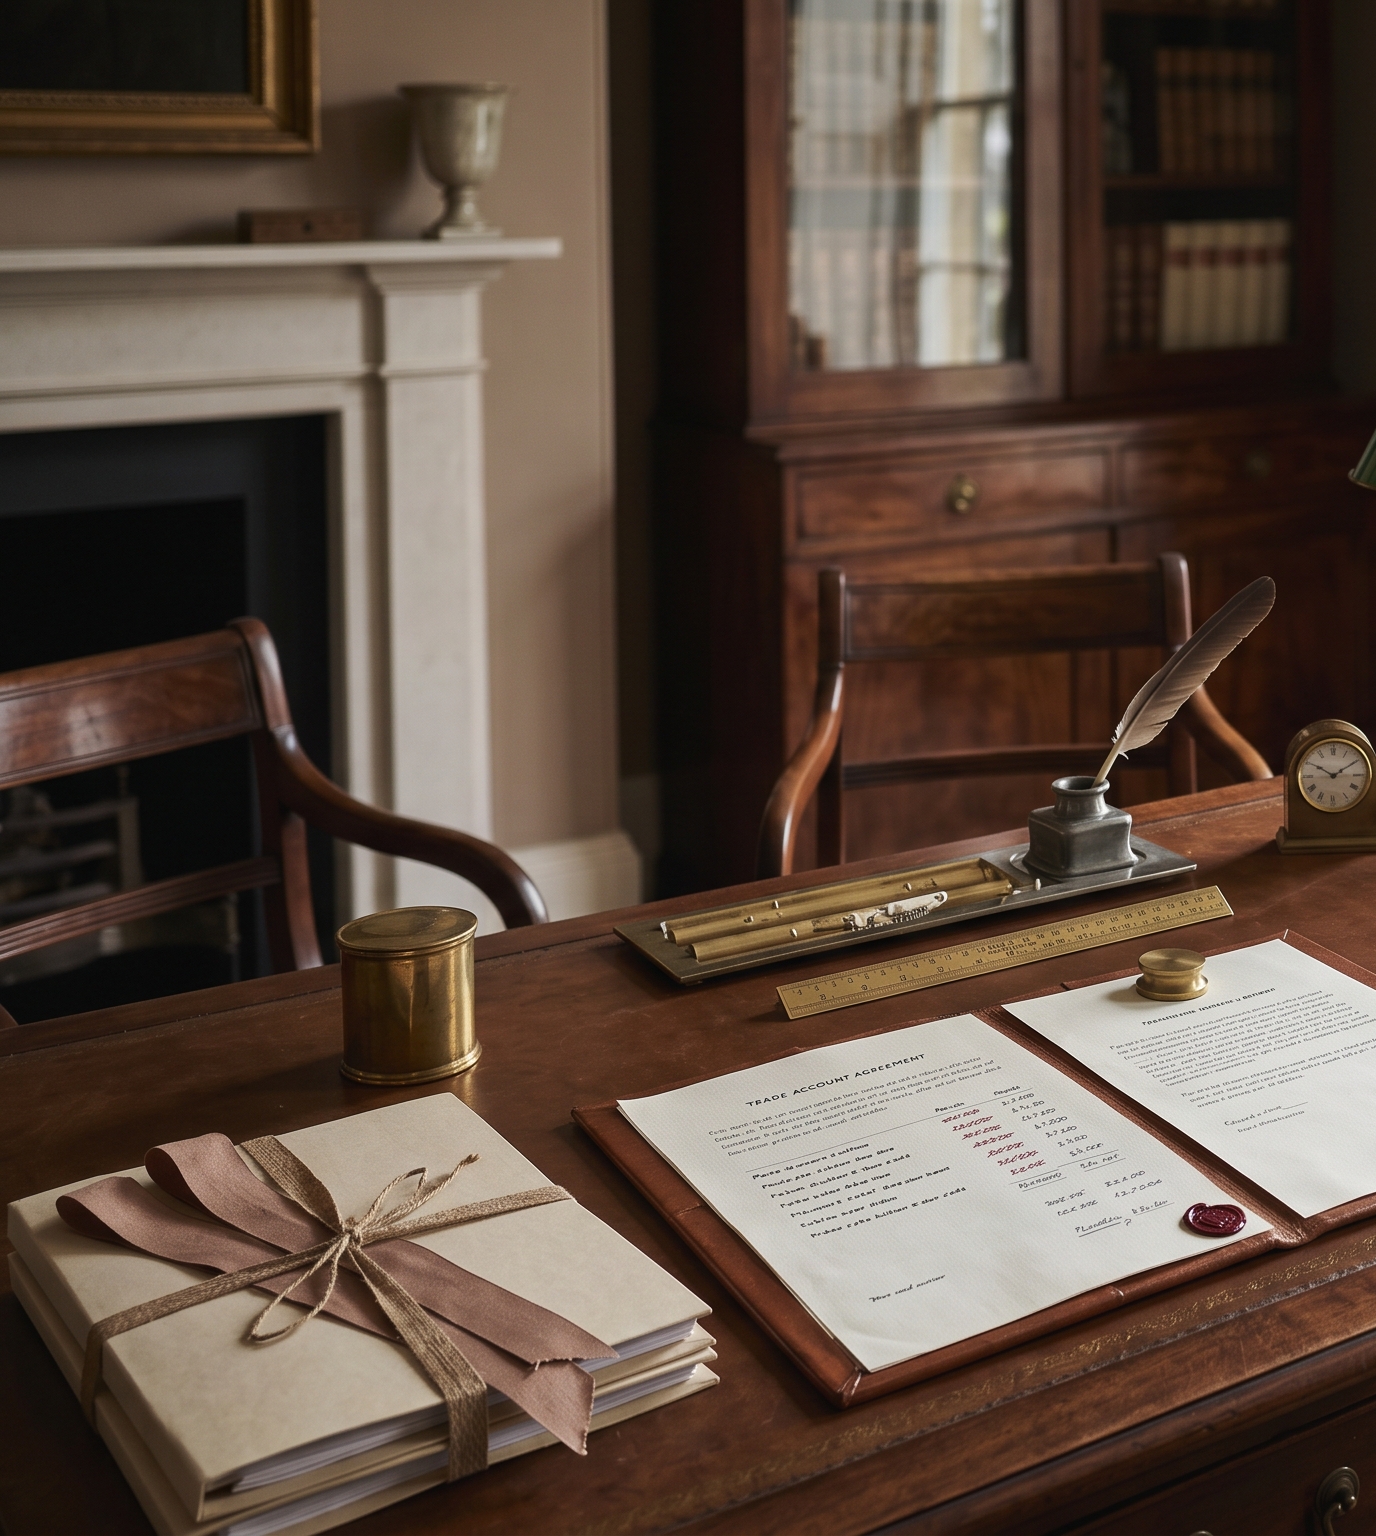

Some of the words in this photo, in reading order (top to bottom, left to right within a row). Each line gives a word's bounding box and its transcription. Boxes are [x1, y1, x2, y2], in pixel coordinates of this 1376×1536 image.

[745, 1092, 788, 1107] TRADE
[792, 1074, 850, 1095] ACCOUNT
[854, 1053, 925, 1078] AGREEMENT
